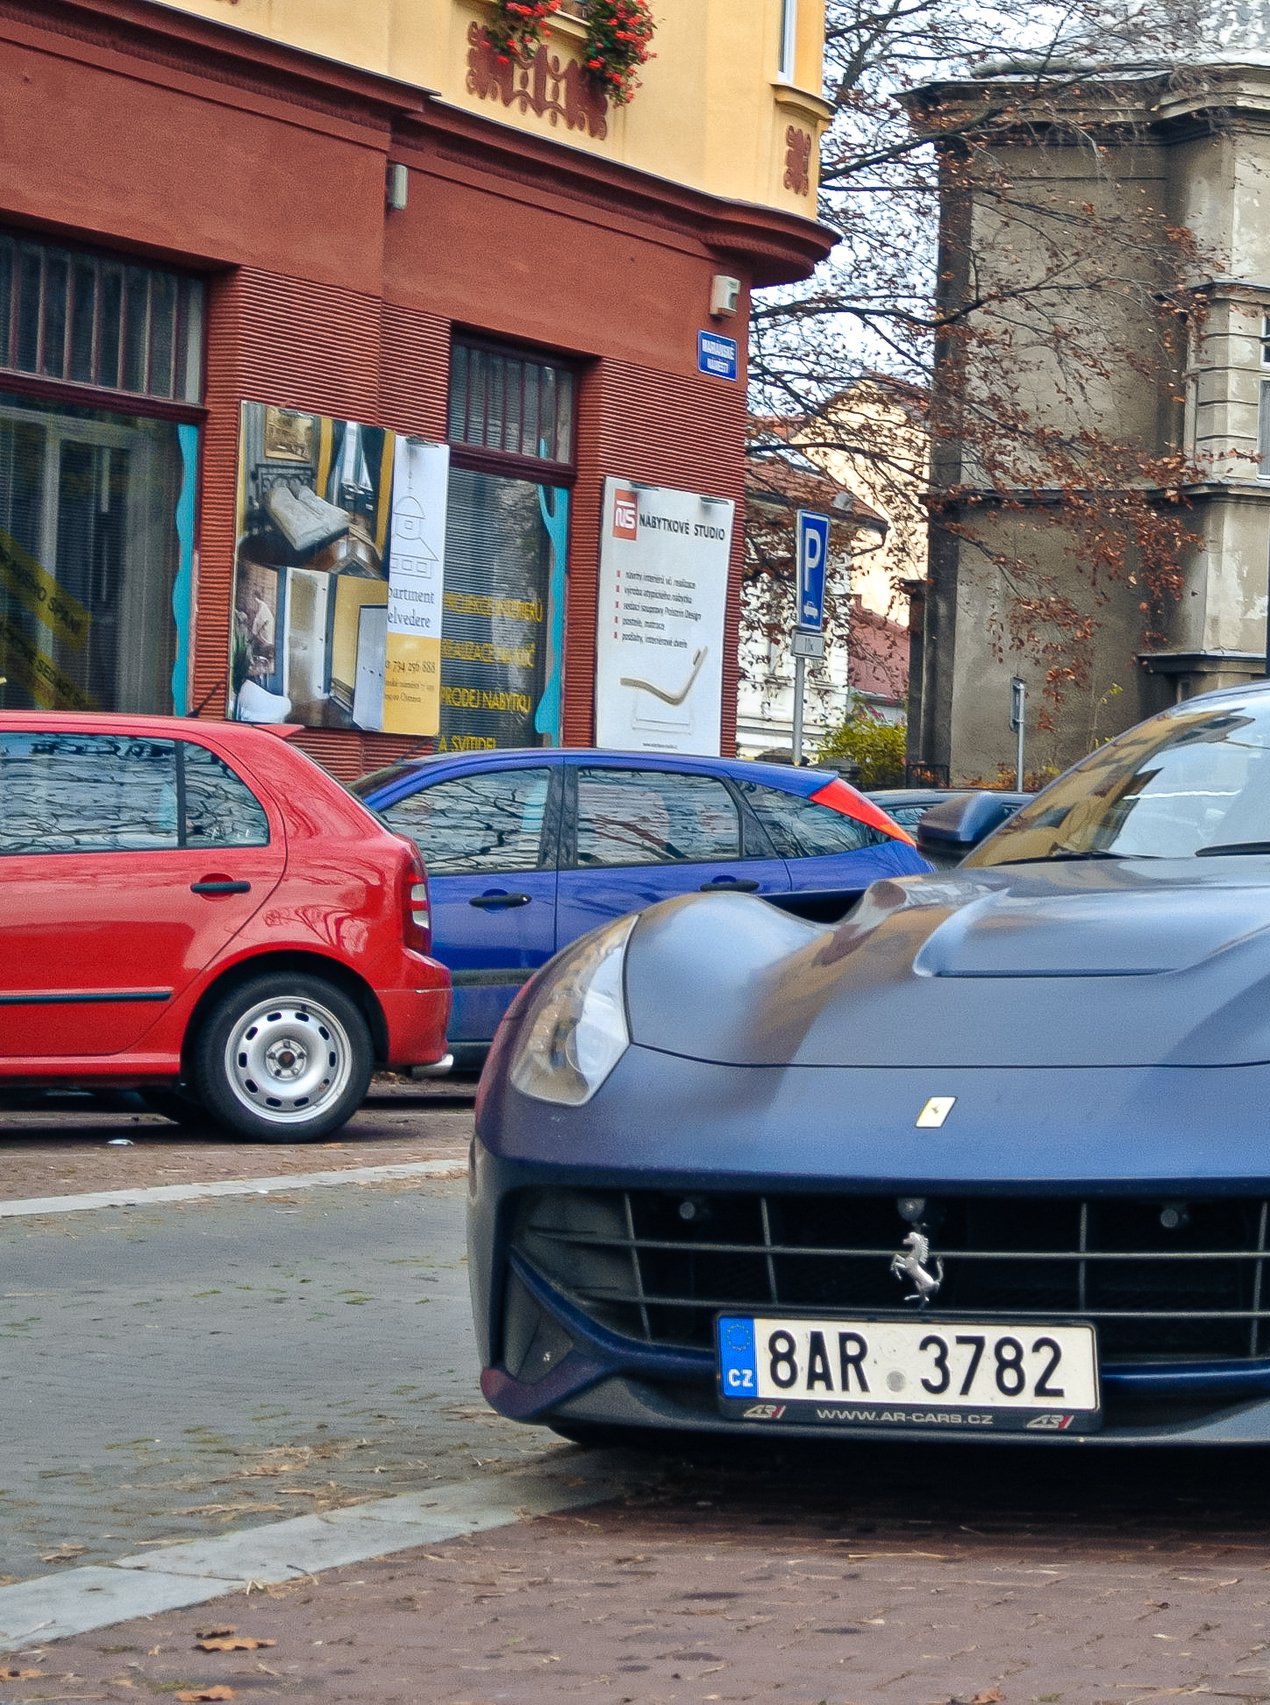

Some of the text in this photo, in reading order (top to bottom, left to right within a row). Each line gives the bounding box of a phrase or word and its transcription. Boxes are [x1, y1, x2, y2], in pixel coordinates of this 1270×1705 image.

[640, 511, 726, 540] NÁBYTKOVÉ STUDIO
[804, 528, 821, 592] P
[685, 609, 701, 622] Design
[440, 685, 480, 708] PRODEJ
[768, 1329, 1064, 1397] 8AR 3782
[728, 1369, 754, 1388] CZ
[816, 1408, 994, 1424] WWW.AR-CARS.CZ
